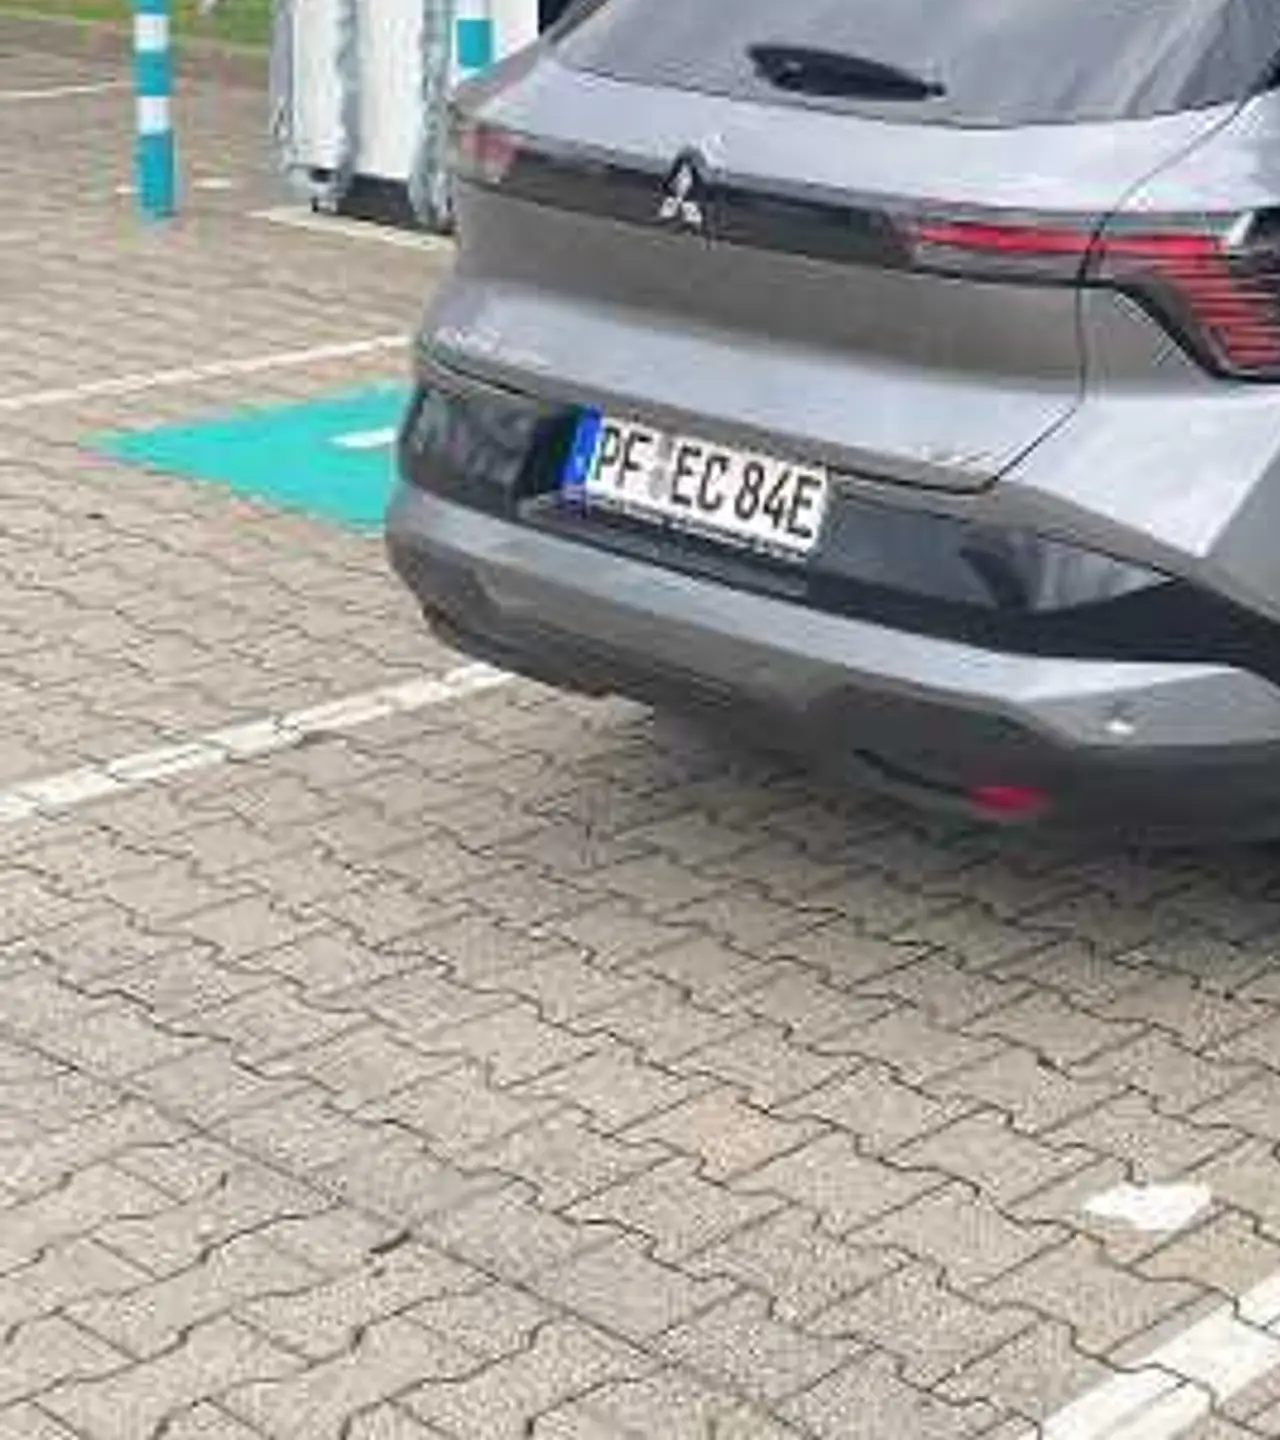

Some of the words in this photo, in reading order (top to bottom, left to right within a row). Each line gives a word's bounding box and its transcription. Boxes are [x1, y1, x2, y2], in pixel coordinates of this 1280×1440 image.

[593, 424, 653, 489] PF
[670, 443, 732, 512] EC
[734, 461, 822, 539] 84E
